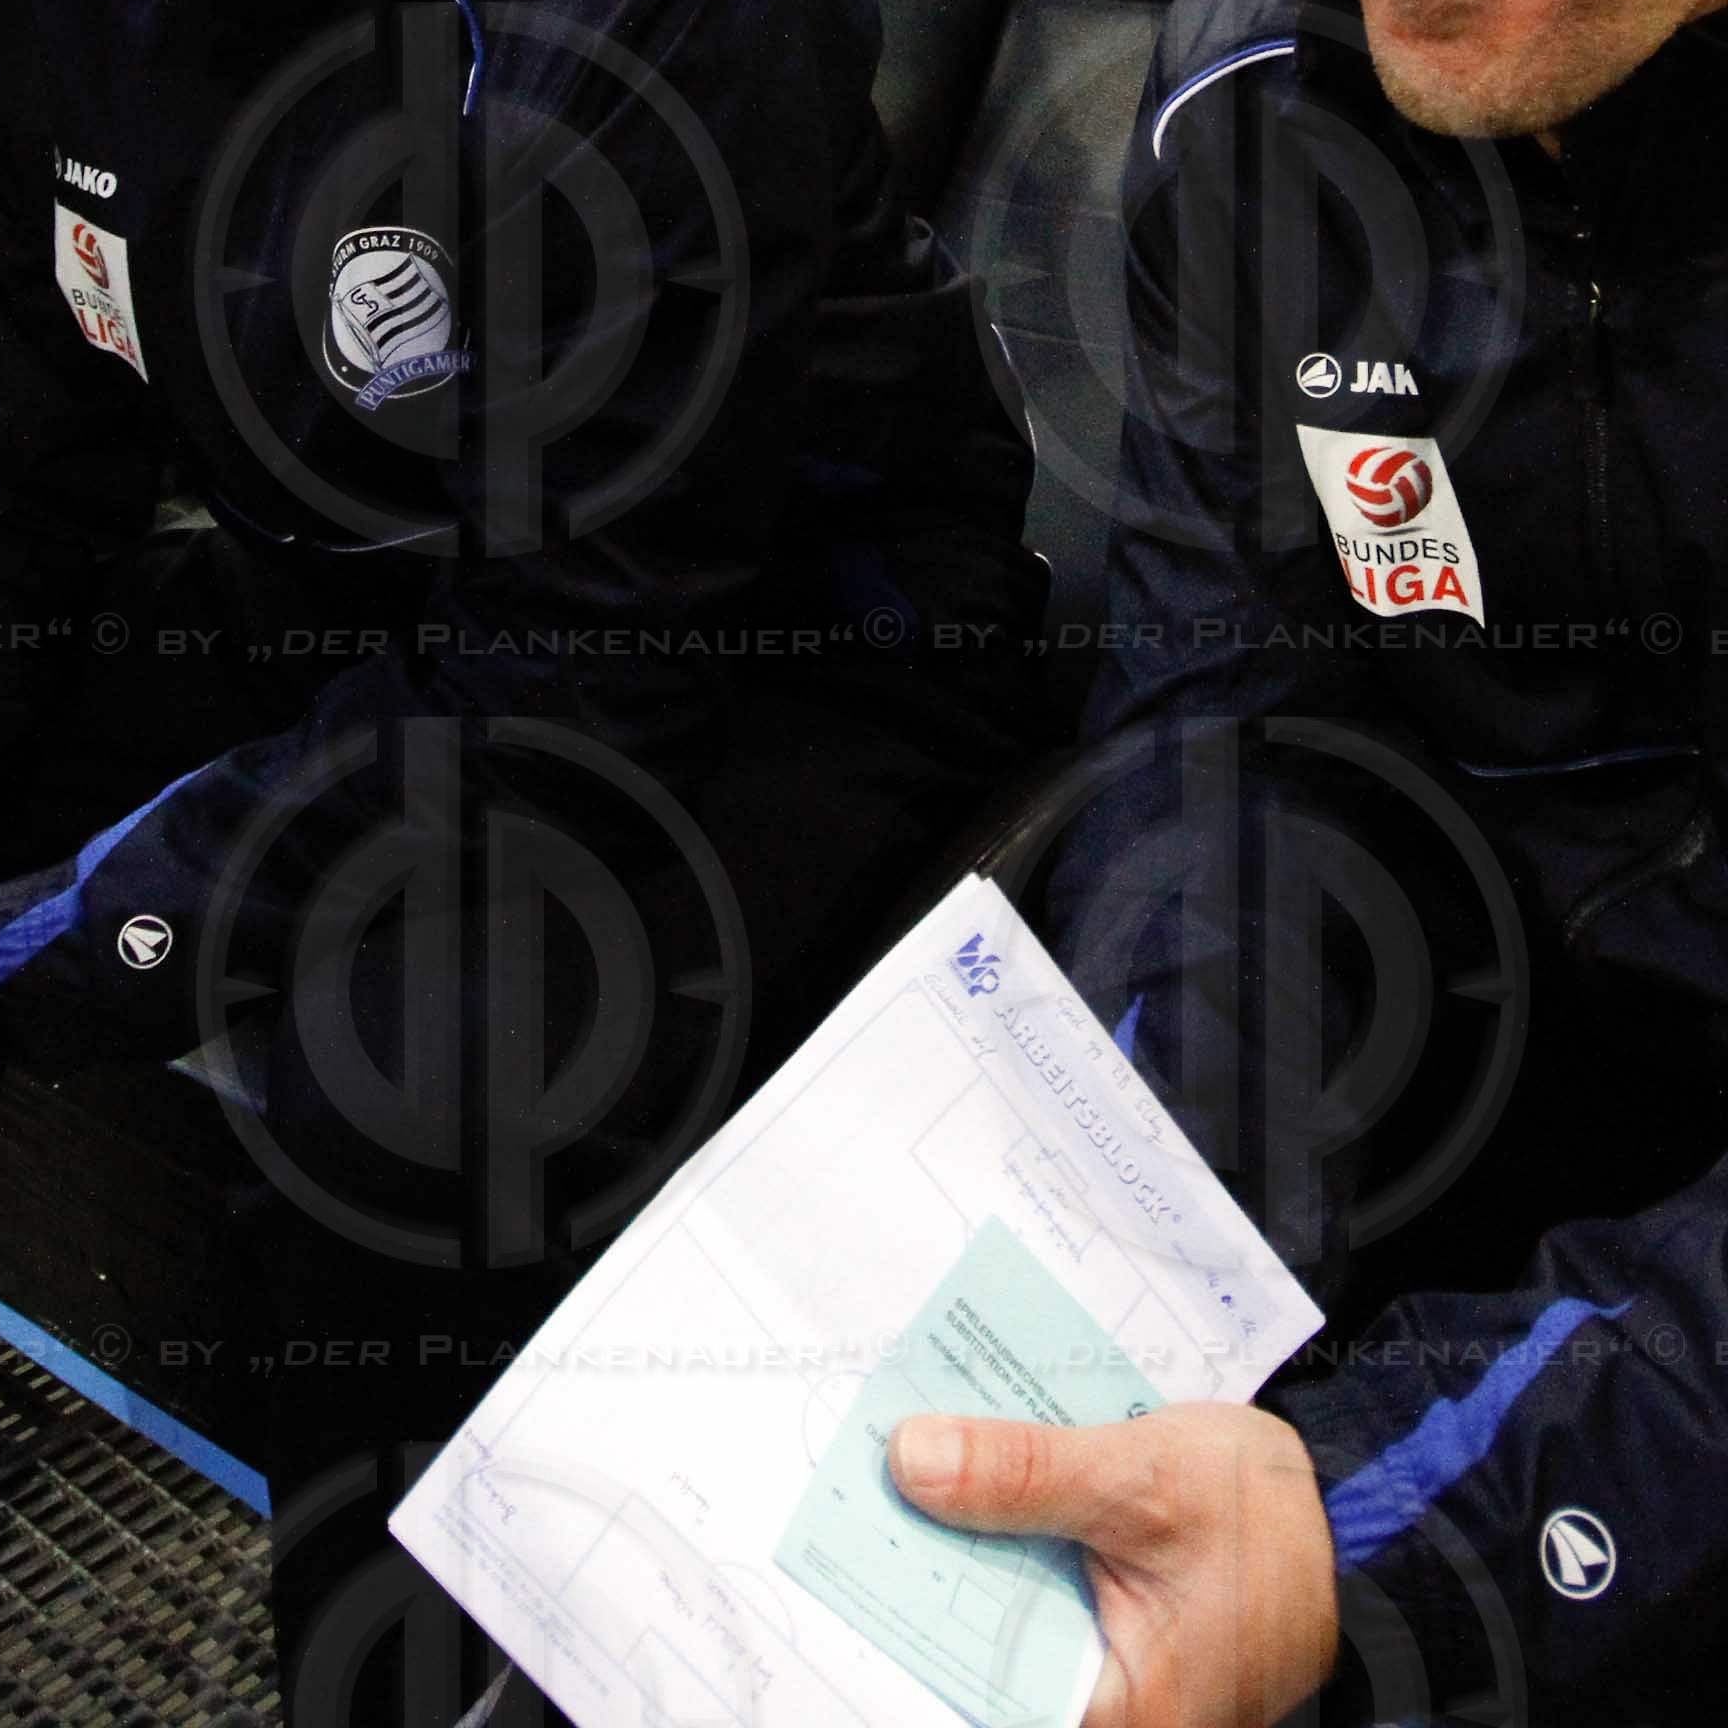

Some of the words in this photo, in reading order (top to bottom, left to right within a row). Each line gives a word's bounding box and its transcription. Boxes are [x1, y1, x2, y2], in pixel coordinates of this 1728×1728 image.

[64, 158, 117, 199] JAKO
[359, 235, 401, 250] GRAZ
[361, 354, 471, 409] PUNTIGAMER
[1350, 360, 1420, 396] JAK
[1335, 532, 1460, 565] BUNDES
[1342, 558, 1471, 608] LIGA
